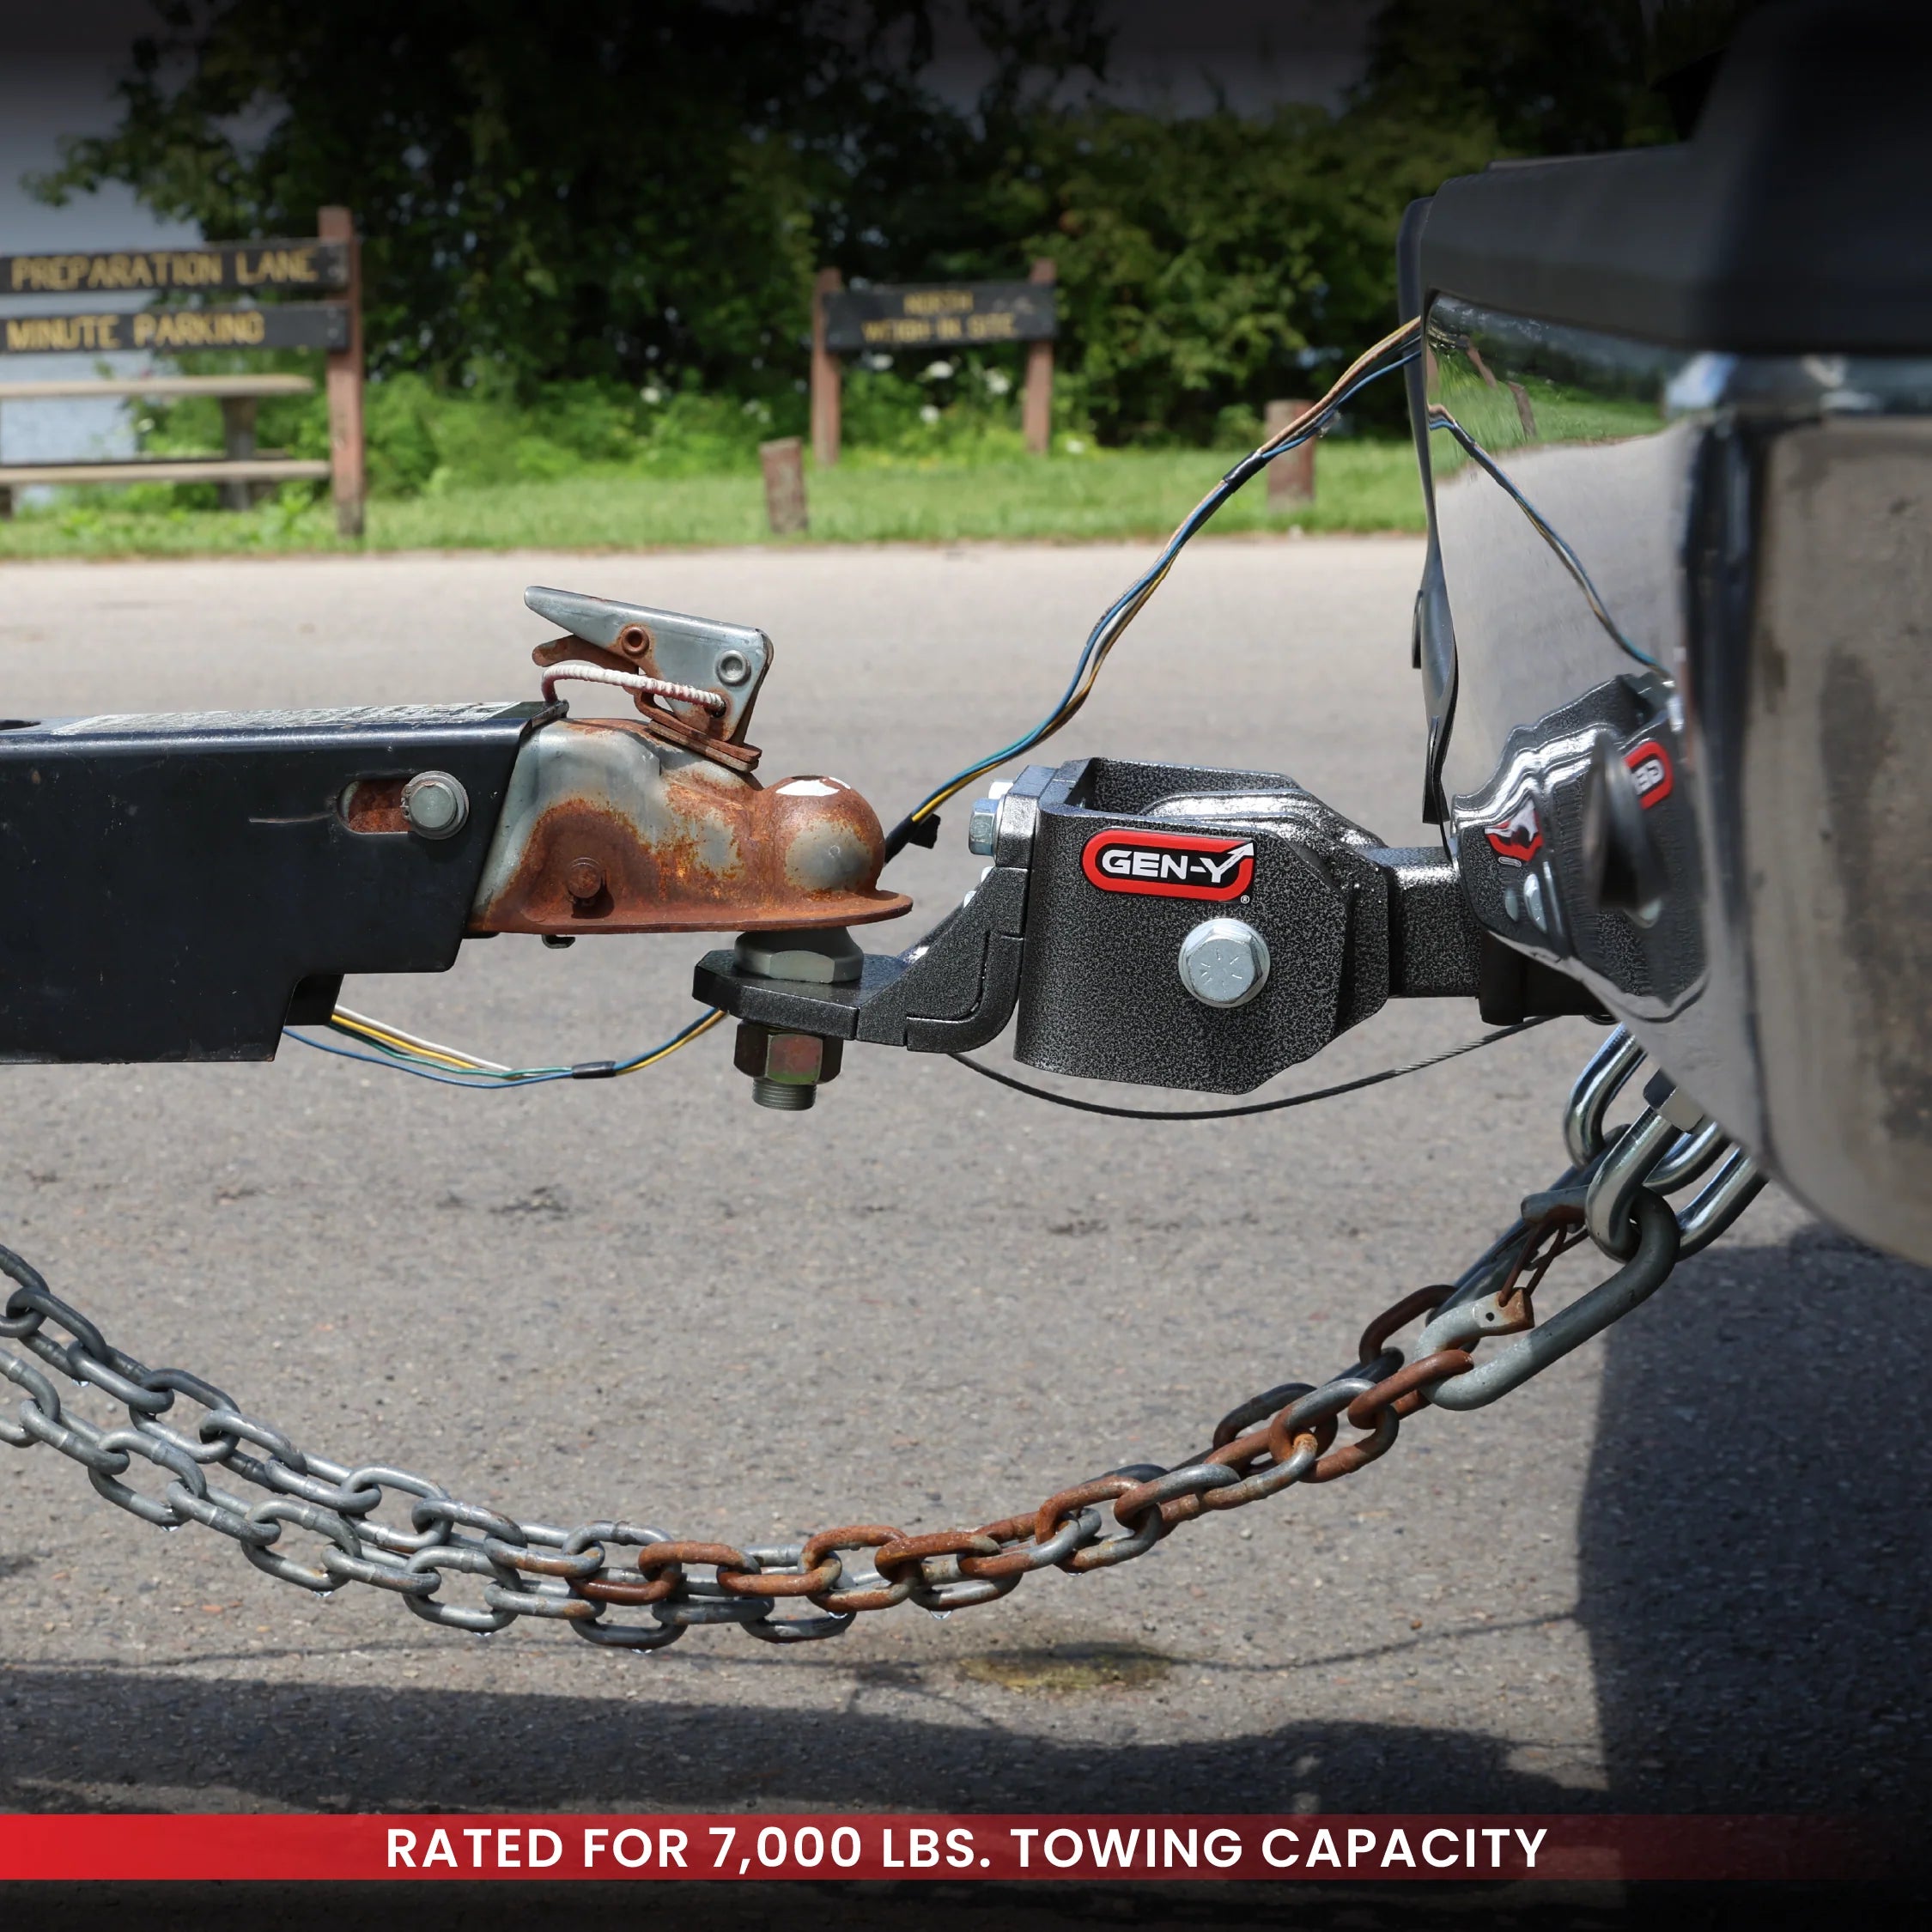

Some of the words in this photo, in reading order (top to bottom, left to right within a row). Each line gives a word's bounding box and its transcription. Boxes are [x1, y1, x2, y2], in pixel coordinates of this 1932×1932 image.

[11, 252, 222, 291] PREPARATION
[235, 248, 319, 285] LANE
[6, 315, 119, 350] MINUTE
[133, 311, 264, 346] PARKING
[1102, 844, 1254, 884] GEN-Y
